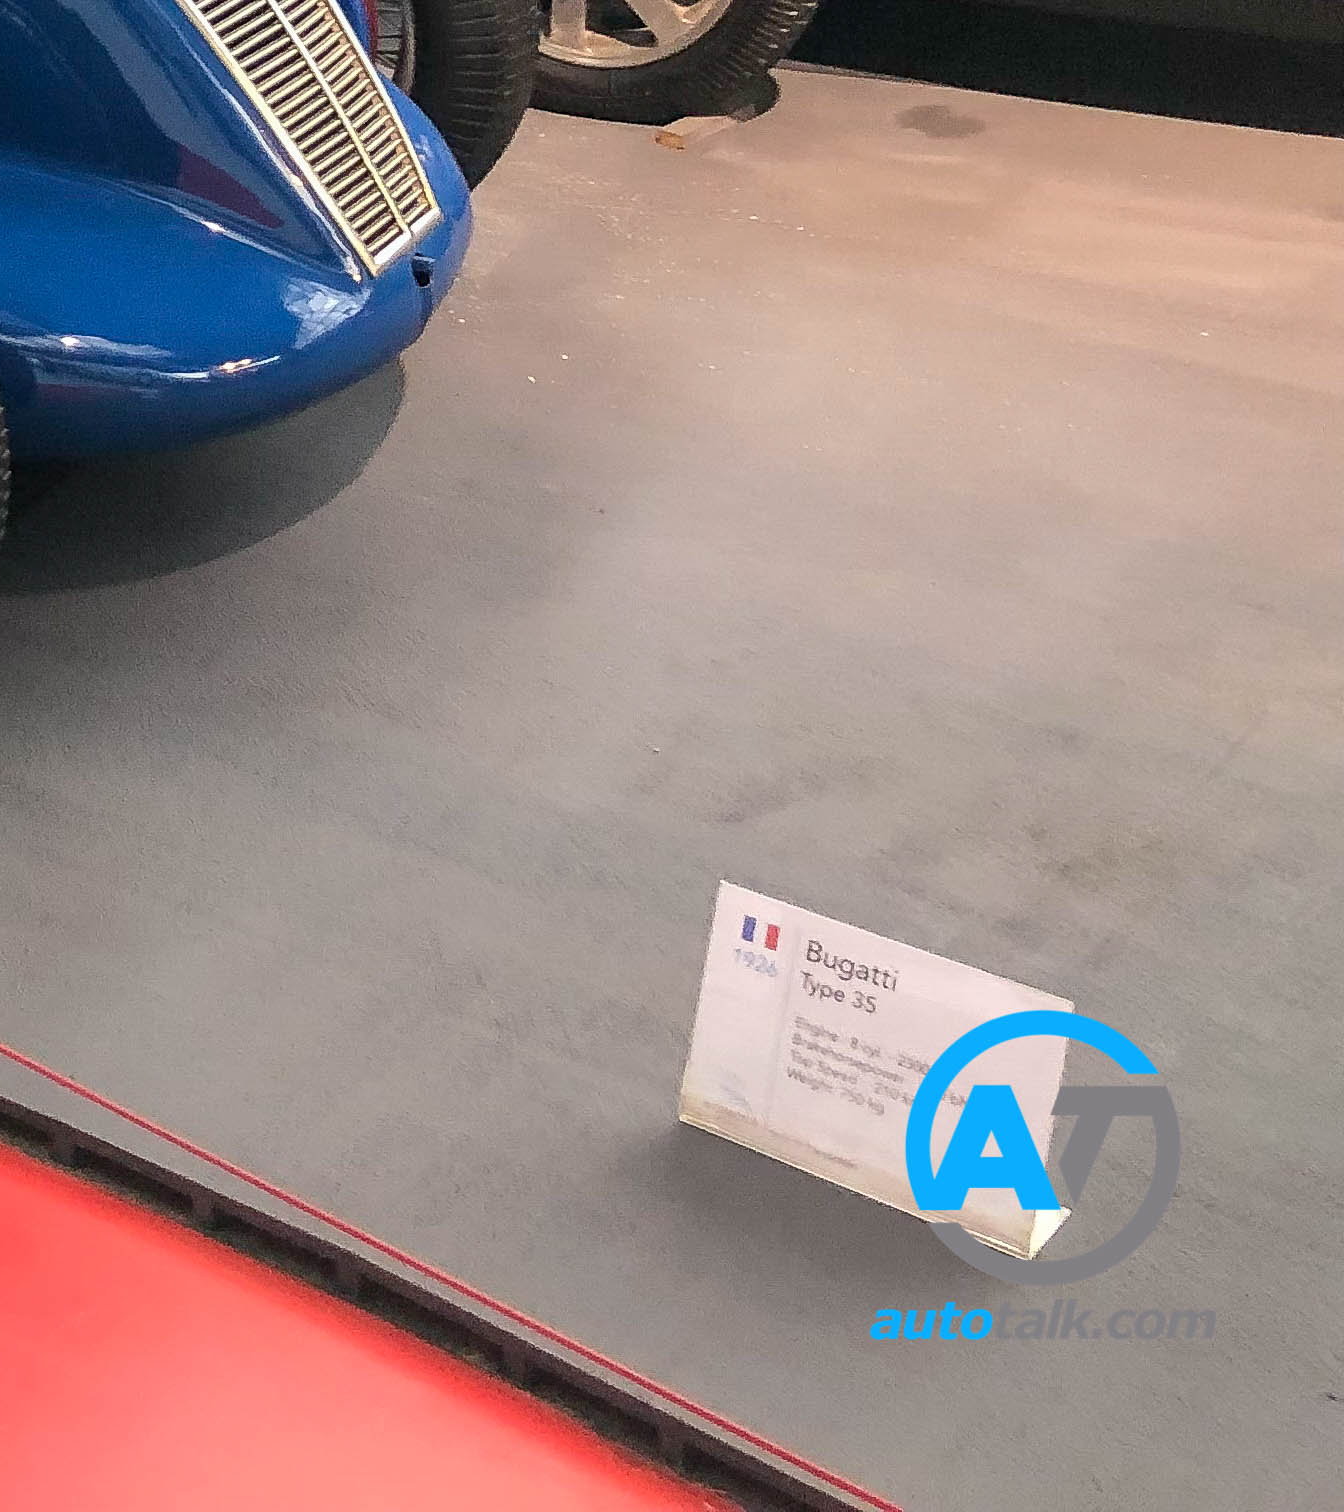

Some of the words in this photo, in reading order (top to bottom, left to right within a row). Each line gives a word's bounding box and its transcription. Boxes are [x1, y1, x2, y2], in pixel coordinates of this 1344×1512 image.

[806, 940, 899, 992] Bugatti
[801, 970, 845, 1003] Type
[851, 990, 878, 1014] 35
